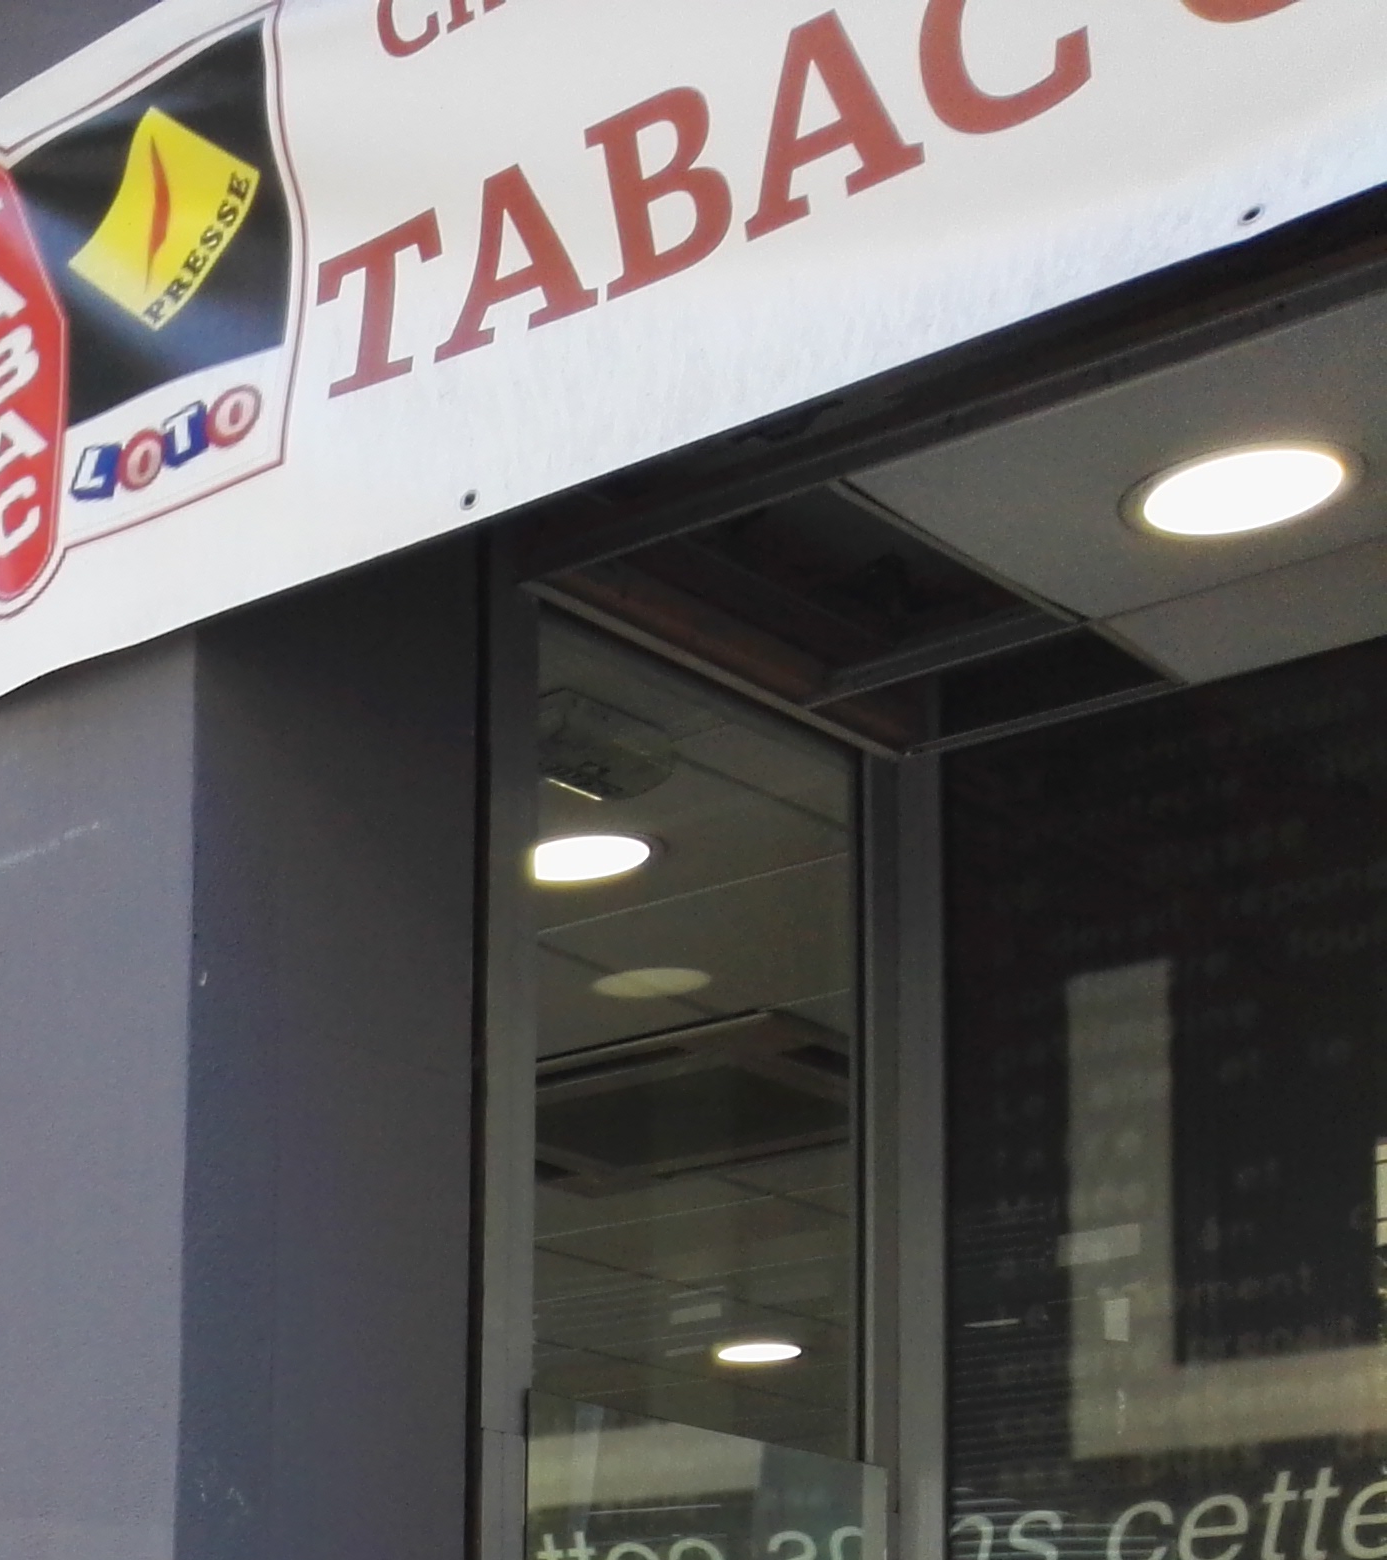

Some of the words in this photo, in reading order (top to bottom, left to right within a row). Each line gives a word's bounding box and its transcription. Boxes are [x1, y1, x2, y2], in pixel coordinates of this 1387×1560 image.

[143, 170, 253, 328] PRESSE
[315, 0, 1091, 399] TABAC
[70, 384, 262, 501] LOTO
